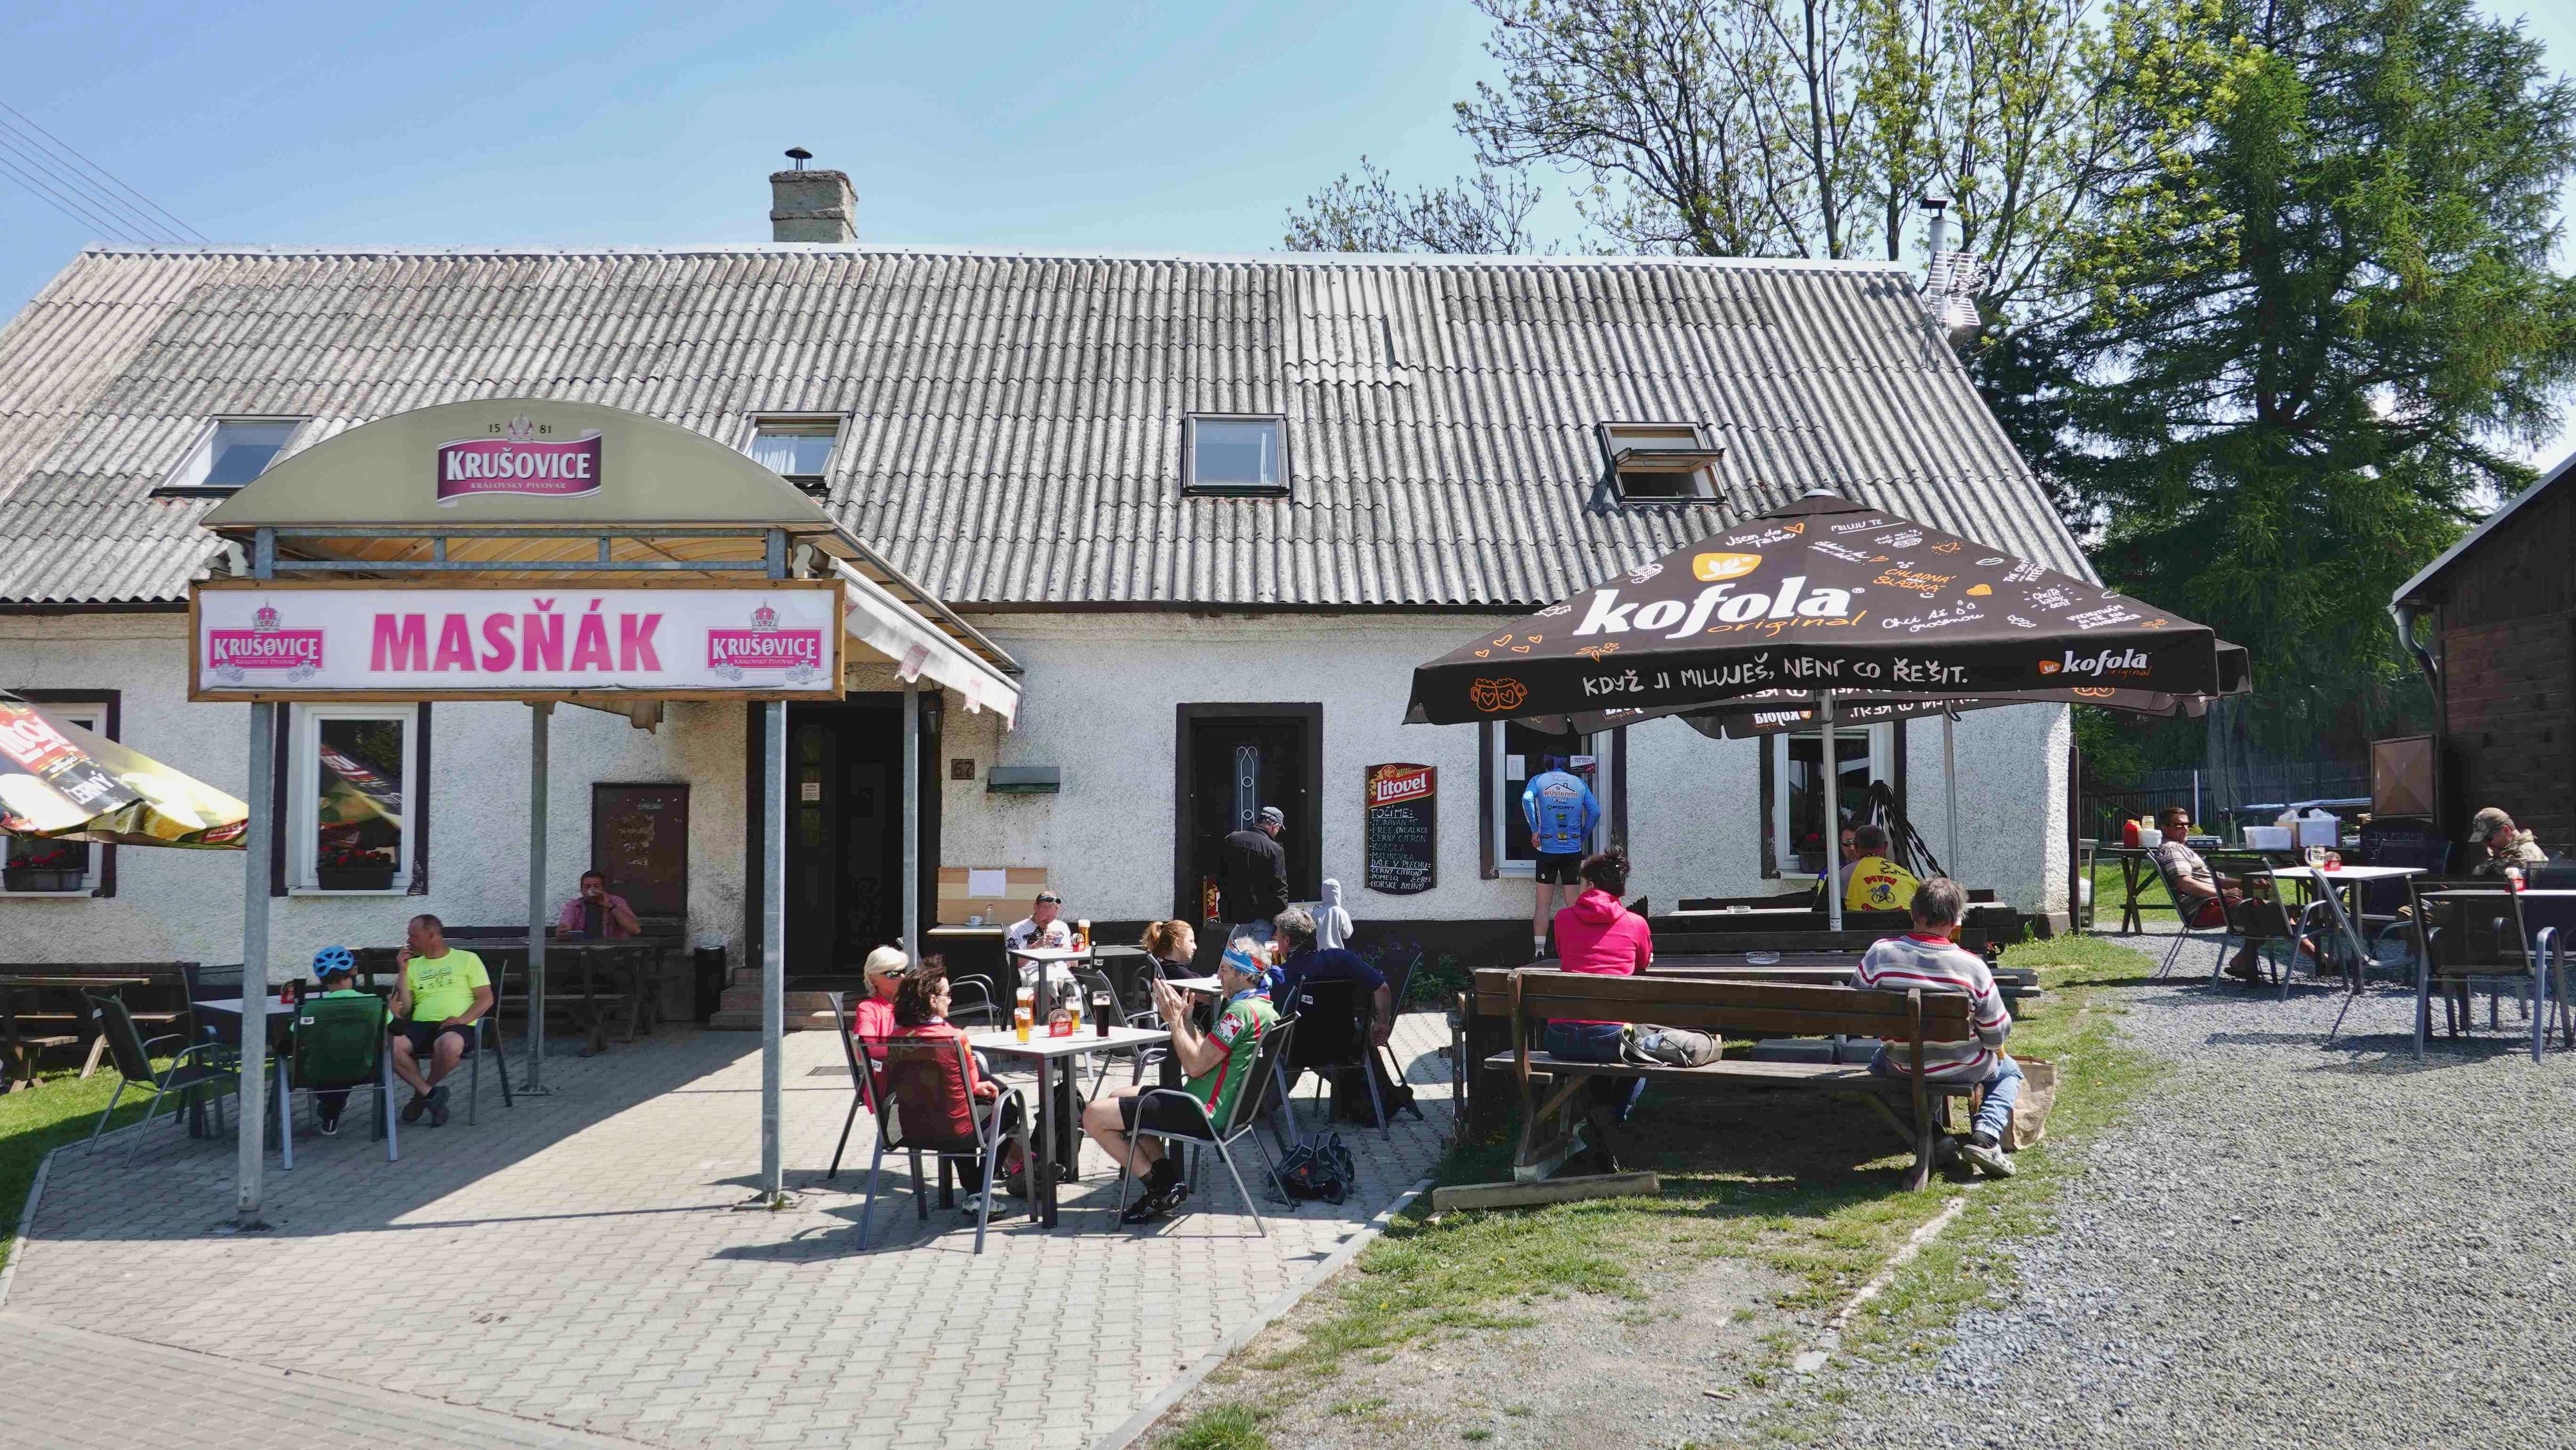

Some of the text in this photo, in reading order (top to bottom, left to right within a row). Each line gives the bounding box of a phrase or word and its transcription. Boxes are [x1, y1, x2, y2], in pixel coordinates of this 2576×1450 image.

[489, 423, 552, 434] 15 81
[446, 446, 592, 481] KRUŠOVICE
[1572, 575, 1851, 640] kofola
[368, 596, 666, 674] MASŇÁK
[1707, 609, 1868, 638] original
[214, 634, 319, 660] KRUŠOVICE
[712, 634, 817, 660] KRUŠOVICE
[1582, 669, 1645, 697] KDYŽ
[1653, 672, 1670, 689] JI
[1783, 656, 1846, 679] NENÍ
[1853, 661, 1881, 678] CO
[1893, 656, 1969, 685] ŘEŠIT.
[2061, 648, 2150, 677] kofola
[954, 761, 973, 777] 67
[1376, 772, 1428, 801] Litovel
